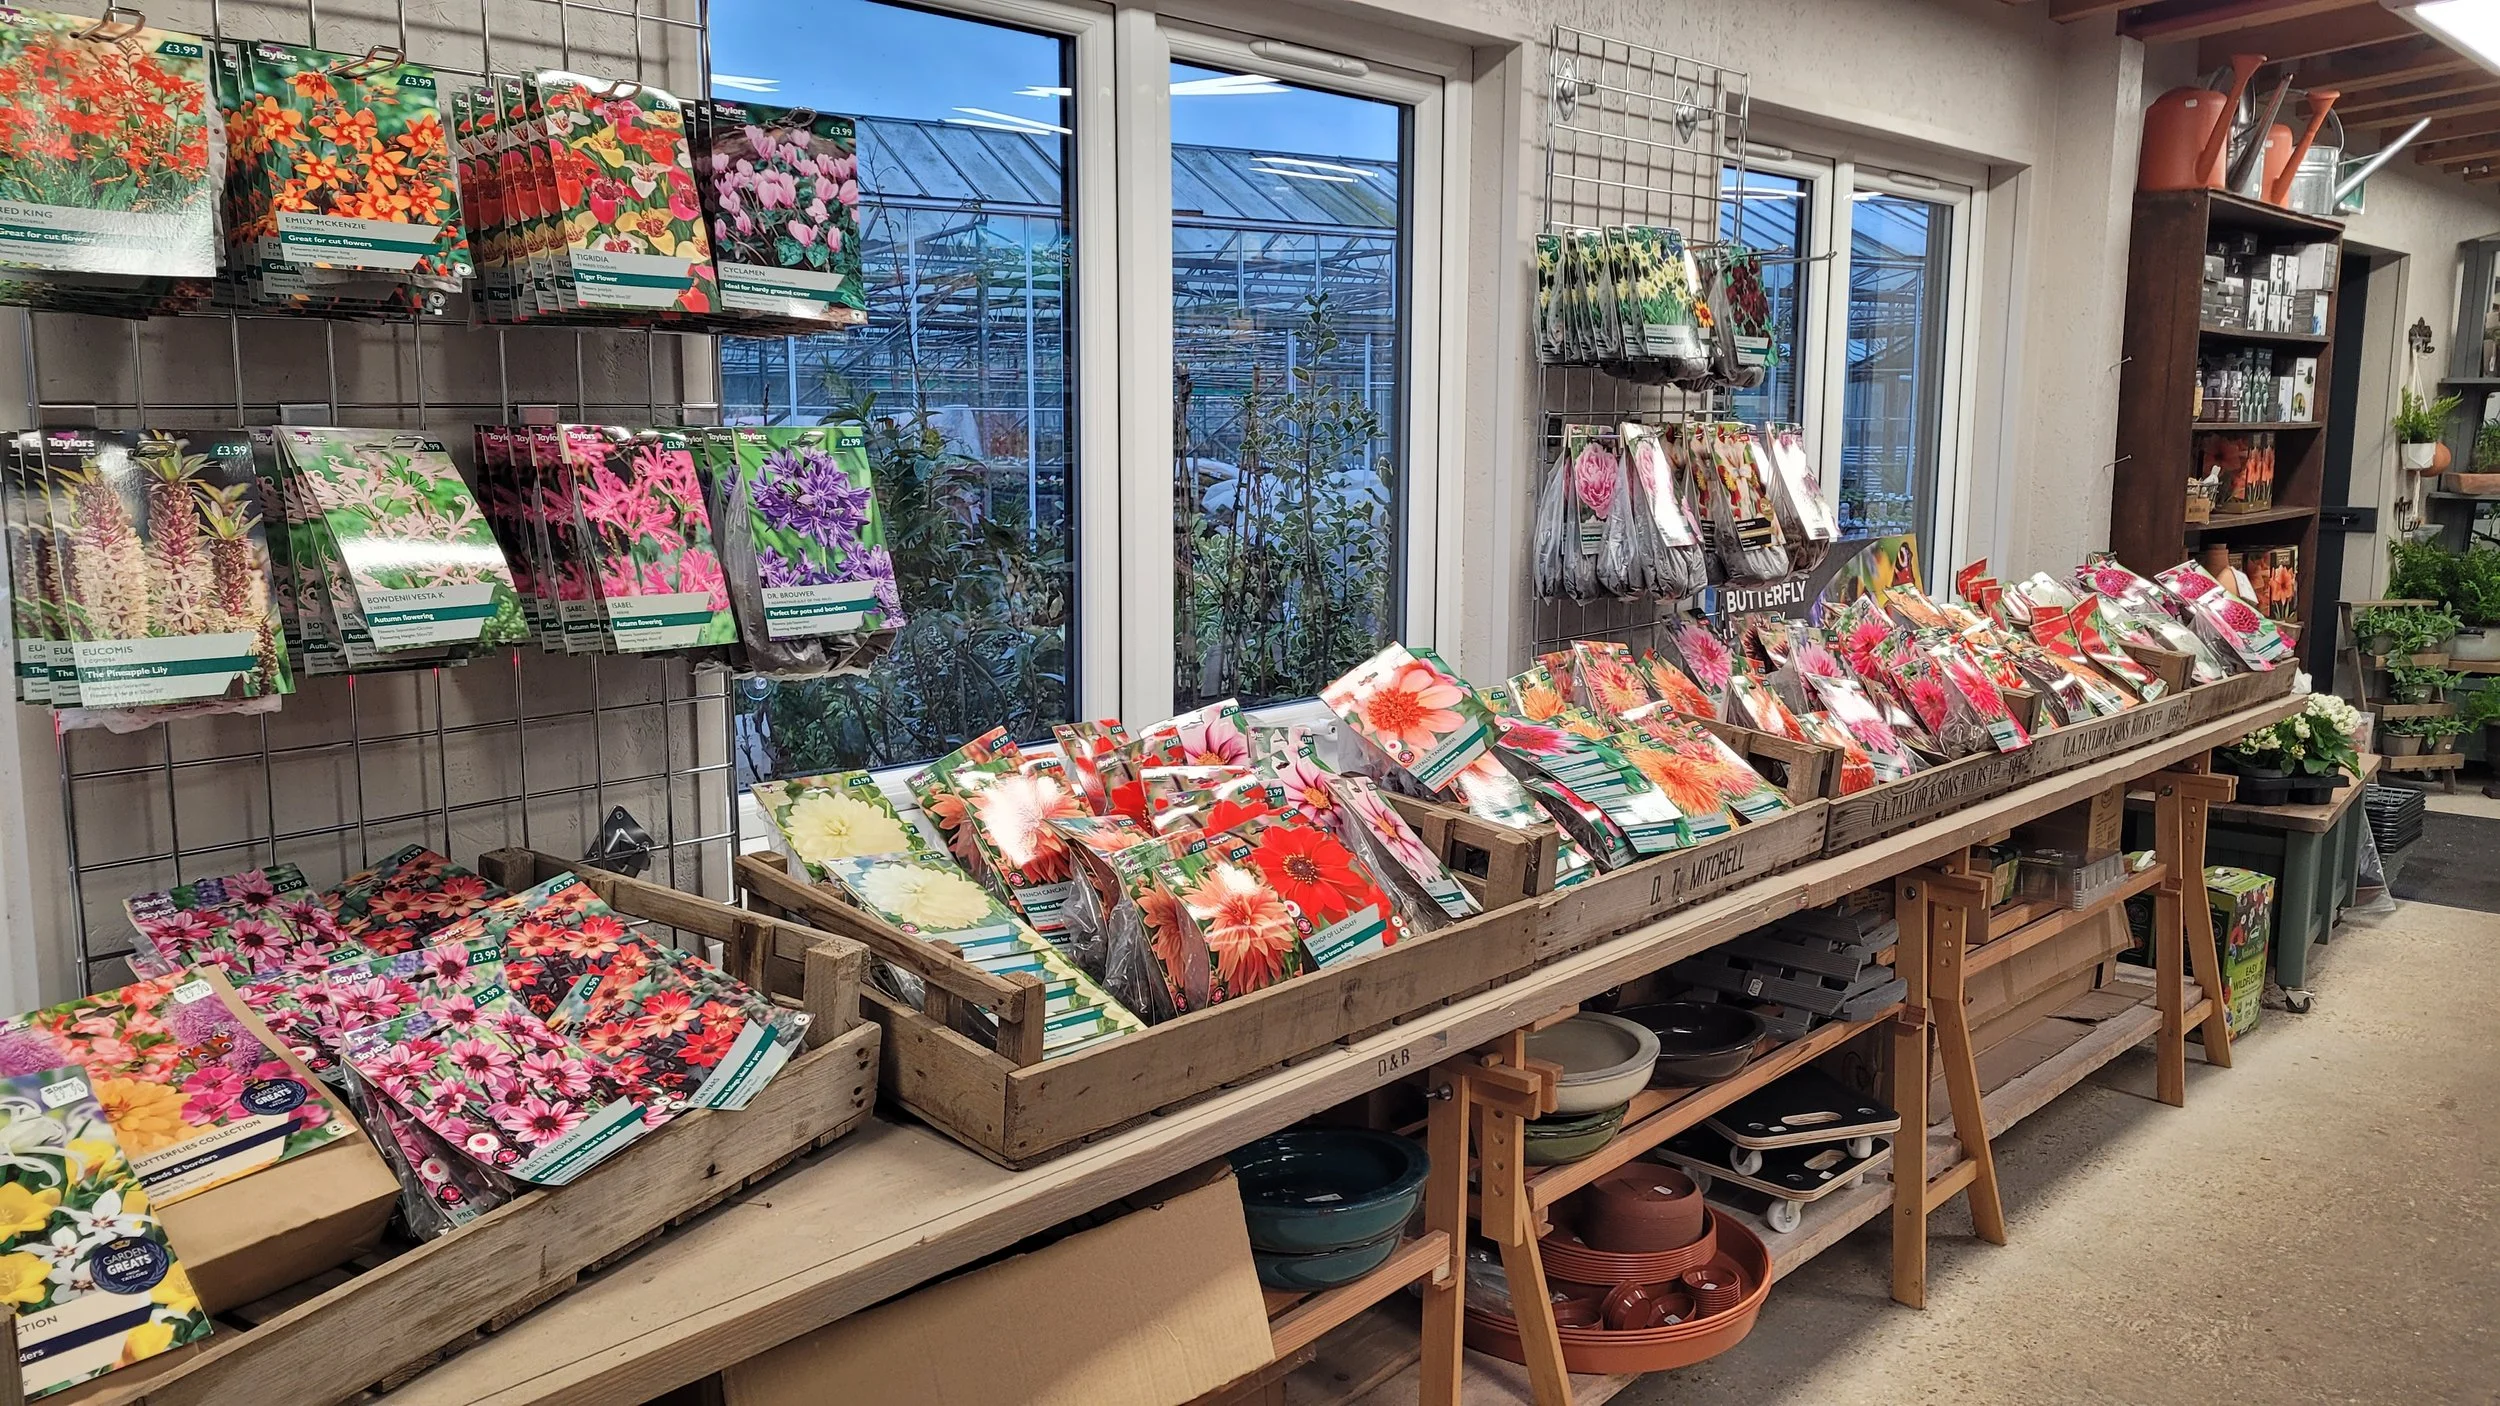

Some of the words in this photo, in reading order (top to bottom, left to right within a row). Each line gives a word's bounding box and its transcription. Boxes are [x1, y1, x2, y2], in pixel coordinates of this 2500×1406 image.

[0, 13, 38, 25] aylors
[165, 43, 198, 55] £3.99
[256, 48, 297, 62] Taylors
[405, 76, 432, 88] £3.99
[475, 93, 494, 105] Tayl
[715, 104, 747, 116] Taylors
[831, 126, 852, 136] £3.99
[23, 208, 53, 219] KING
[285, 216, 312, 225] EMILY
[316, 219, 366, 230] MCKENZIE
[0, 228, 24, 238] Great
[27, 230, 41, 239] for
[44, 233, 60, 241] cut
[61, 234, 96, 243] flowers
[288, 234, 313, 244] Great
[342, 238, 373, 247] flowers
[576, 253, 609, 263] TIGRIDIA
[579, 272, 596, 282] Tiger
[597, 273, 618, 282] Flower
[723, 267, 765, 276] CYCLAMEN
[292, 434, 327, 445] Taylors
[568, 432, 595, 441] Taylors
[738, 432, 767, 441] Taylors
[841, 437, 861, 446] £2.99
[47, 438, 95, 450] Taylors
[667, 440, 685, 449] £3.99
[217, 446, 247, 456] £3.99
[367, 594, 411, 604] BOWDENII
[412, 592, 436, 601] VESTA
[767, 592, 778, 600] DR.
[780, 591, 815, 599] BROUWER
[1726, 580, 1806, 613] BUTTERFLY
[374, 613, 401, 623] Autumn
[402, 611, 434, 622] flowering
[770, 609, 789, 617] Perfect
[800, 608, 812, 616] pots
[813, 606, 824, 614] and
[825, 605, 847, 613] borders
[348, 632, 370, 641] Autum
[82, 645, 133, 656] EUCOMIS
[30, 666, 48, 675] The
[56, 669, 74, 678] The
[86, 669, 105, 679] The
[106, 667, 150, 679] Pineapple
[152, 665, 168, 676] Lily
[1223, 706, 1239, 715] £3.99
[2106, 726, 2112, 746] &
[2112, 719, 2131, 746] SONS
[2131, 712, 2150, 739] BULBS
[993, 735, 1008, 749] £3.99
[1166, 737, 1180, 748] £3.99
[1412, 755, 1432, 771] TOTALLY
[1432, 737, 1457, 757] TANGERINE
[1422, 771, 1434, 780] Great
[1445, 751, 1460, 763] flowers
[852, 776, 870, 786] £3.99
[911, 772, 937, 787] Taylors
[1928, 787, 1935, 808] &
[1937, 775, 1961, 804] SONS
[1961, 768, 1987, 796] BULBS
[1283, 809, 1298, 819] £3.99
[1192, 840, 1206, 853] £3.99
[1232, 847, 1248, 859] £3.99
[402, 848, 422, 862] £3.99
[1123, 861, 1143, 874] Taylors
[1160, 865, 1181, 876] Taylors
[1650, 875, 1661, 906] D.
[1690, 843, 1744, 890] MITCHELL
[278, 879, 302, 892] £3.99
[553, 878, 575, 893] £3.99
[138, 906, 178, 920] Taylors
[1309, 936, 1327, 948] BISHOP
[1327, 931, 1335, 939] OF
[473, 949, 497, 963] £3.99
[1317, 952, 1328, 961] Dark
[1328, 946, 1342, 958] bronze
[1342, 940, 1355, 950] foliage
[2245, 963, 2258, 977] EASY
[332, 970, 373, 985] Taylors
[582, 975, 601, 996] £3.99
[477, 987, 500, 1005] £3.99
[355, 1041, 391, 1060] Taylors
[250, 1083, 287, 1099] GARDEN
[255, 1087, 292, 1105] GREATS
[133, 1142, 197, 1169] BUTTERFLIES
[199, 1120, 261, 1145] COLLECTION
[520, 1152, 548, 1174] PRETTY
[548, 1132, 581, 1156] WOMAN
[150, 1169, 172, 1183] beds
[182, 1154, 218, 1170] borders
[456, 1208, 477, 1219] PRET
[102, 1246, 147, 1265] GARDEN
[106, 1254, 152, 1275] GREATS
[121, 1271, 148, 1282] TAYLORS
[16, 1315, 58, 1336] CTION
[20, 1348, 44, 1362] ders
